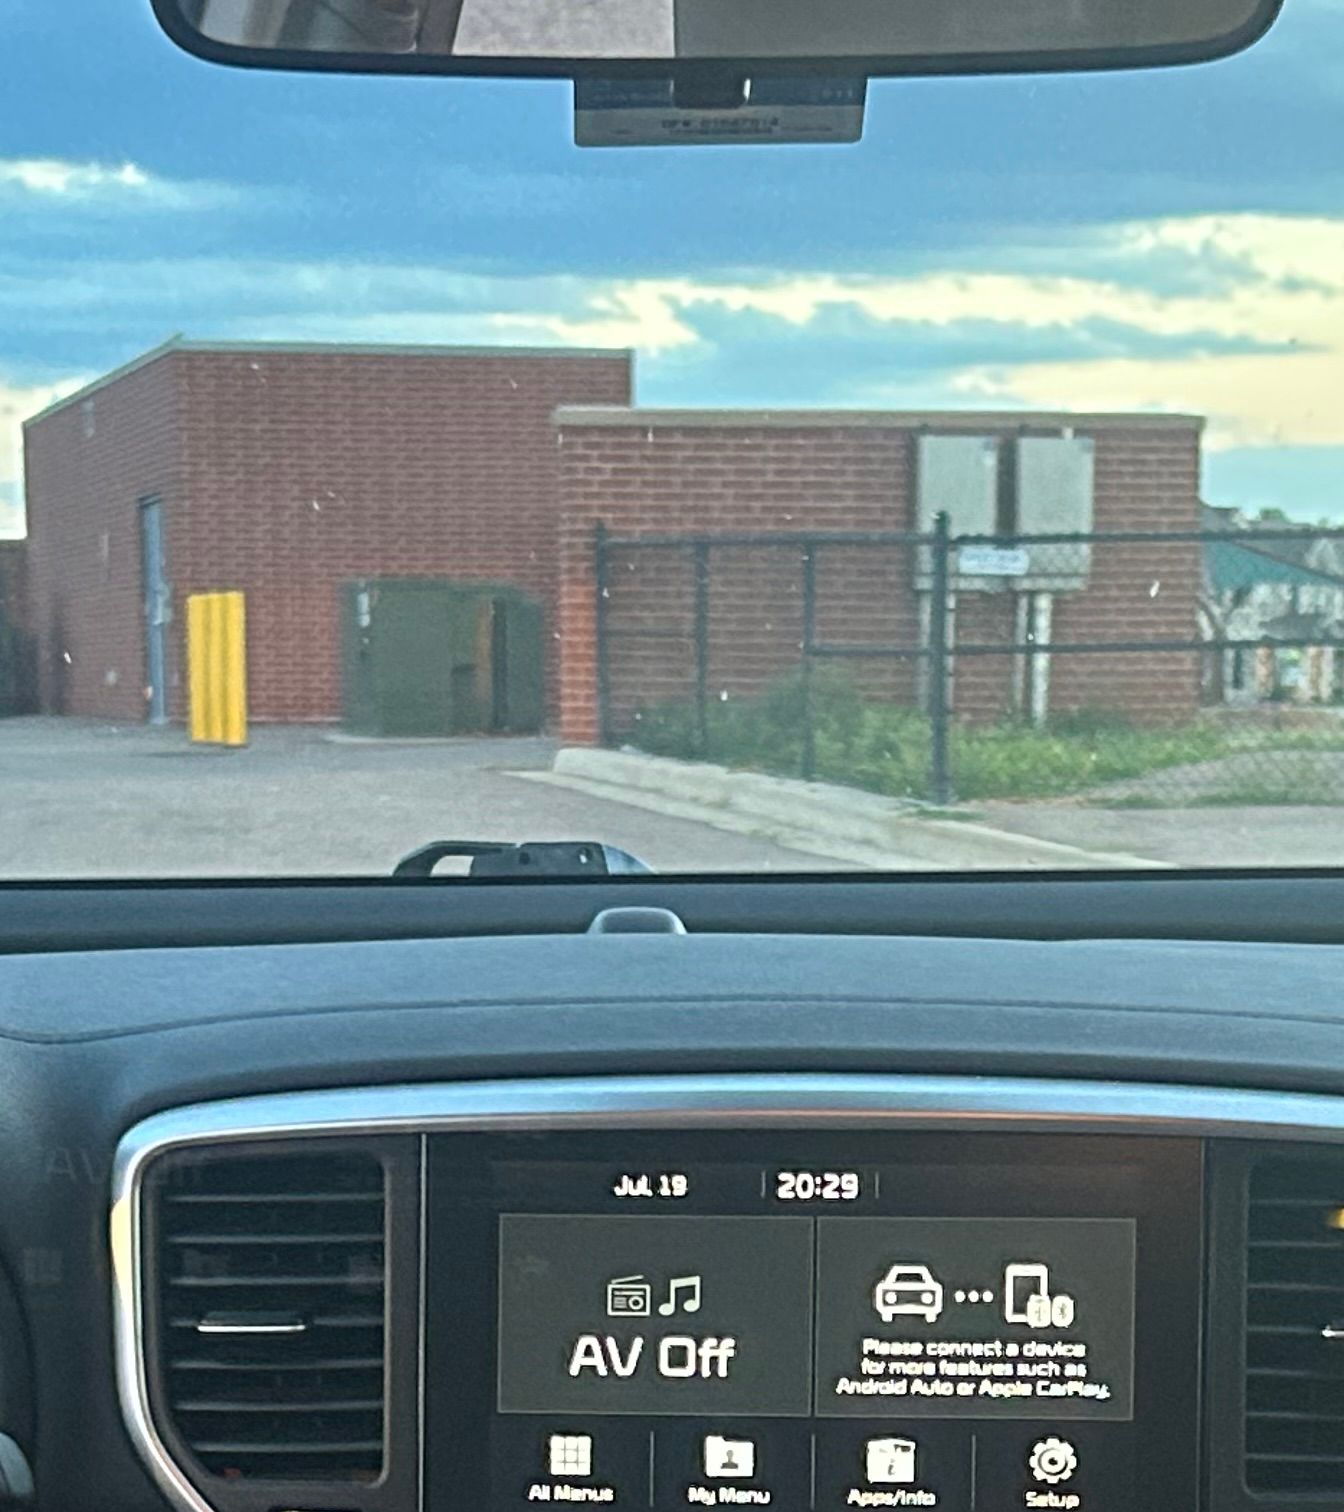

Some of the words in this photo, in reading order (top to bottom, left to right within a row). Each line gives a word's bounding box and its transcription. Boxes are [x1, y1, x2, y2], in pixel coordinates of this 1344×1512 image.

[613, 1173, 652, 1198] Jul
[659, 1173, 688, 1197] 19
[776, 1172, 859, 1199] 20:29
[568, 1335, 644, 1377] AV
[658, 1333, 737, 1378] Off
[862, 1338, 924, 1356] Please
[926, 1340, 1003, 1357] connect
[1005, 1343, 1019, 1356] a
[1022, 1340, 1086, 1357] device
[861, 1358, 885, 1375] for
[889, 1362, 936, 1376] more
[939, 1360, 1014, 1377] features
[1016, 1360, 1060, 1377] such
[1064, 1363, 1087, 1377] as
[835, 1378, 907, 1396] Android
[910, 1379, 954, 1396] Auto
[956, 1382, 976, 1396] or
[978, 1380, 1034, 1399] Apple
[528, 1485, 551, 1501] All
[555, 1485, 614, 1502] Menus
[688, 1486, 716, 1505] My
[719, 1486, 771, 1504] Menu
[846, 1488, 937, 1508] Apps/Info
[1025, 1491, 1080, 1509] Setup
